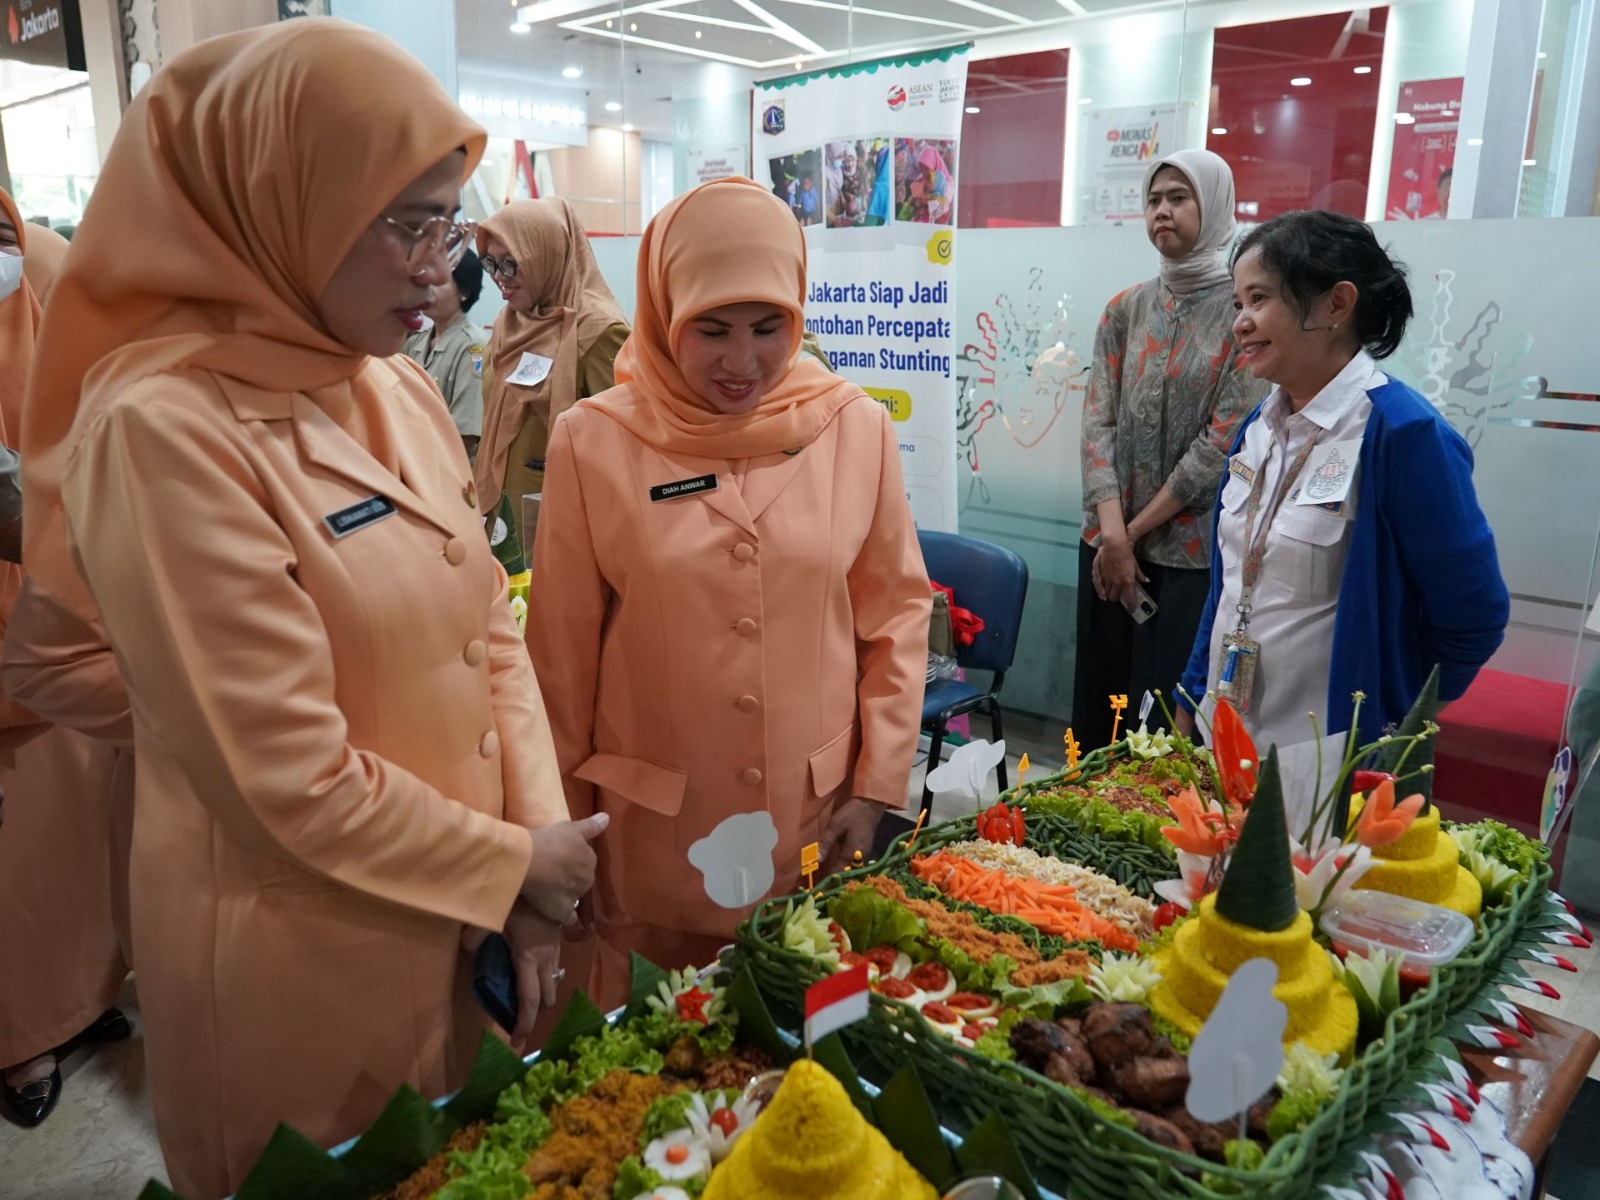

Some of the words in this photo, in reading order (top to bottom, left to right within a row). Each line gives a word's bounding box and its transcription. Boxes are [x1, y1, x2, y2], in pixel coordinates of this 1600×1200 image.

[21, 6, 60, 42] Jakarta
[909, 83, 933, 94] ASEAN
[1120, 128, 1152, 141] MONAS
[808, 281, 866, 303] Jakarta
[870, 281, 904, 308] Siap
[909, 281, 948, 304] Jadi
[804, 314, 864, 336] ontohan
[823, 350, 876, 371] ganan
[879, 348, 950, 378] Stunting
[662, 485, 679, 495] DIAH
[680, 480, 706, 491] ANWAR
